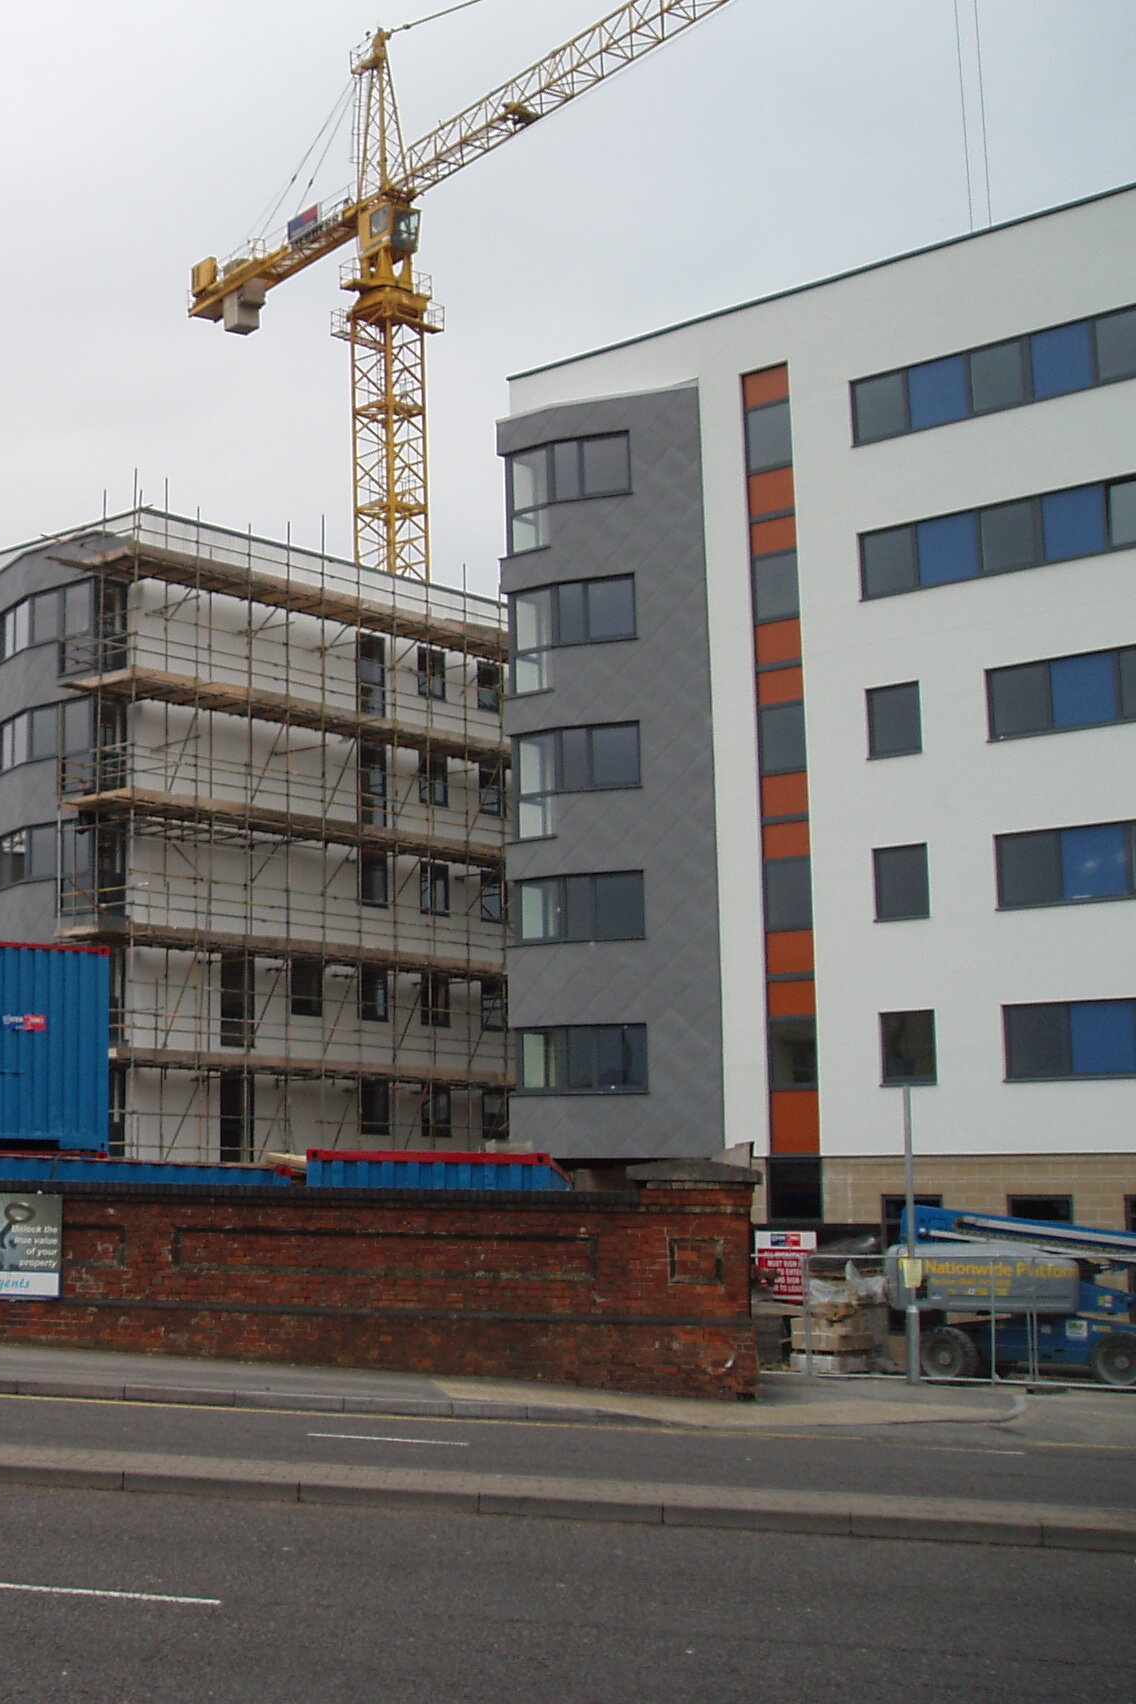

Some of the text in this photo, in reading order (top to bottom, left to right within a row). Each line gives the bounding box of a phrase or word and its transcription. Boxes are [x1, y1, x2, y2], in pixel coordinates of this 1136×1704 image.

[12, 1225, 58, 1234] Unlock the
[34, 1236, 58, 1245] value
[26, 1247, 58, 1257] of your
[19, 1259, 57, 1269] property
[925, 1259, 1013, 1276] Nationwide
